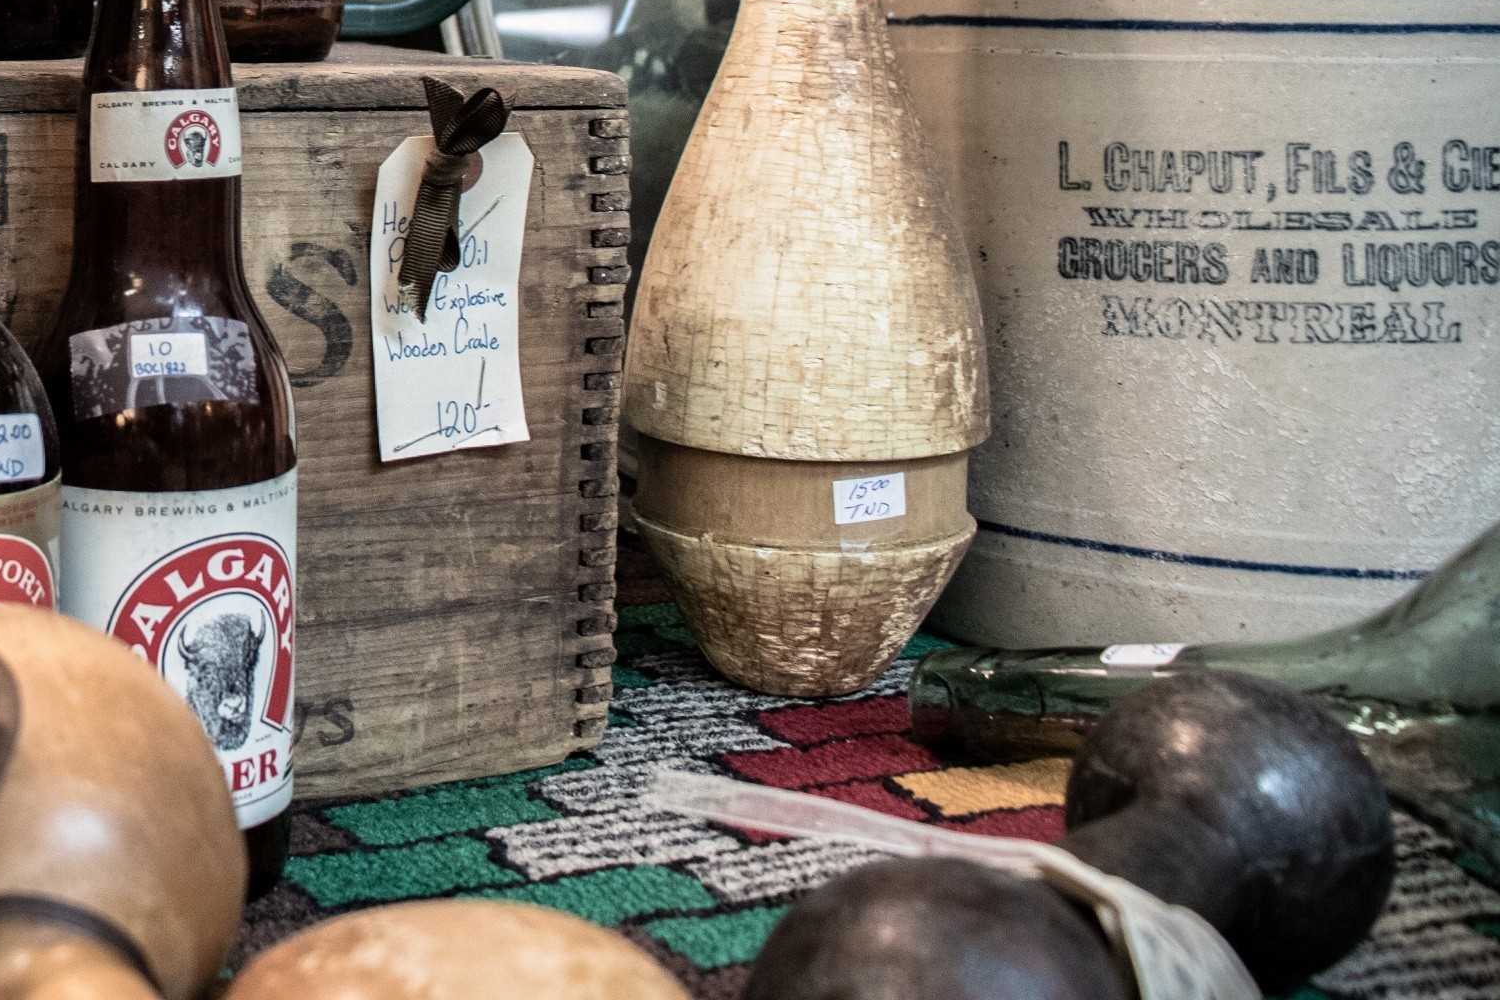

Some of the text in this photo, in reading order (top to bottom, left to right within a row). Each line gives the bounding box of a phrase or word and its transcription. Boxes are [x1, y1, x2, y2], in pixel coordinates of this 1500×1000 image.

[141, 99, 185, 108] BREWING
[167, 112, 220, 151] CALGARY
[99, 161, 157, 169] CALGARY
[1058, 140, 1092, 192] L.
[1285, 142, 1374, 195] FILS
[1386, 140, 1428, 195] &
[1081, 206, 1479, 232] WHOLESALE
[1056, 235, 1500, 292] GROCERS AND LIQUORS
[434, 274, 507, 320] Explosive
[1100, 294, 1463, 345] MONTREAL
[148, 341, 173, 357] 10
[384, 316, 500, 363] Wooden Crate
[62, 499, 125, 516] ALGARY
[134, 504, 218, 517] BREWING
[225, 502, 236, 512] &
[844, 501, 890, 520] TND
